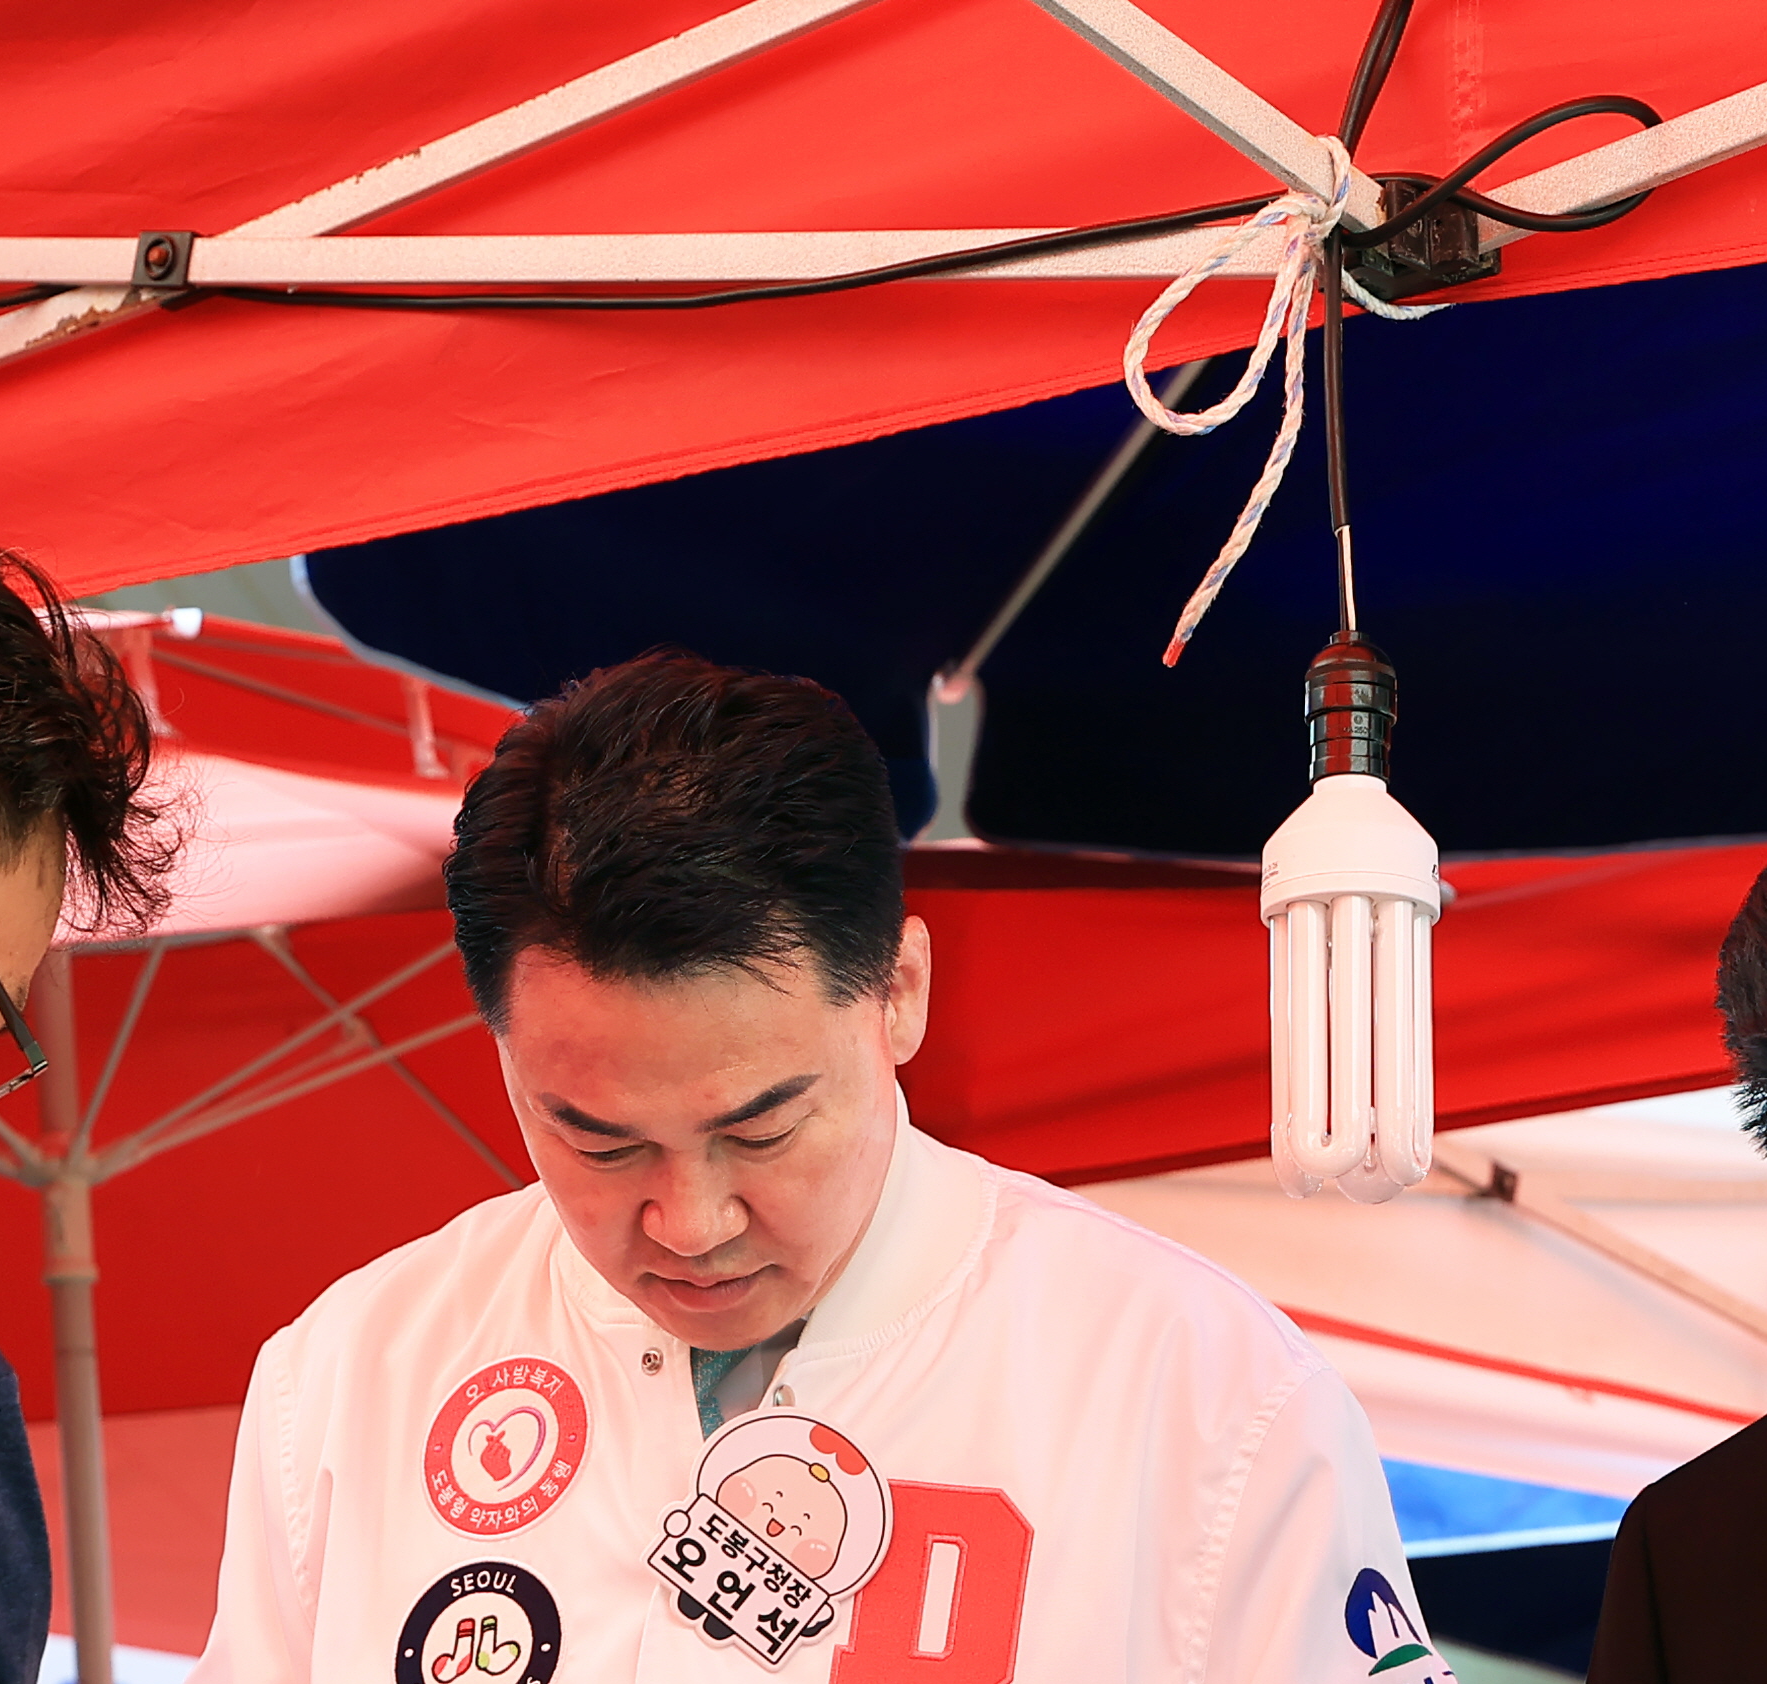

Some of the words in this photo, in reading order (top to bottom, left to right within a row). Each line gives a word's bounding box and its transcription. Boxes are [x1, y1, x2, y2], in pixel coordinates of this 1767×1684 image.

[465, 1384, 485, 1406] 오
[469, 1495, 539, 1529] 약자와의
[698, 1513, 812, 1609] 도봉구청장
[450, 1570, 517, 1597] SEOUL
